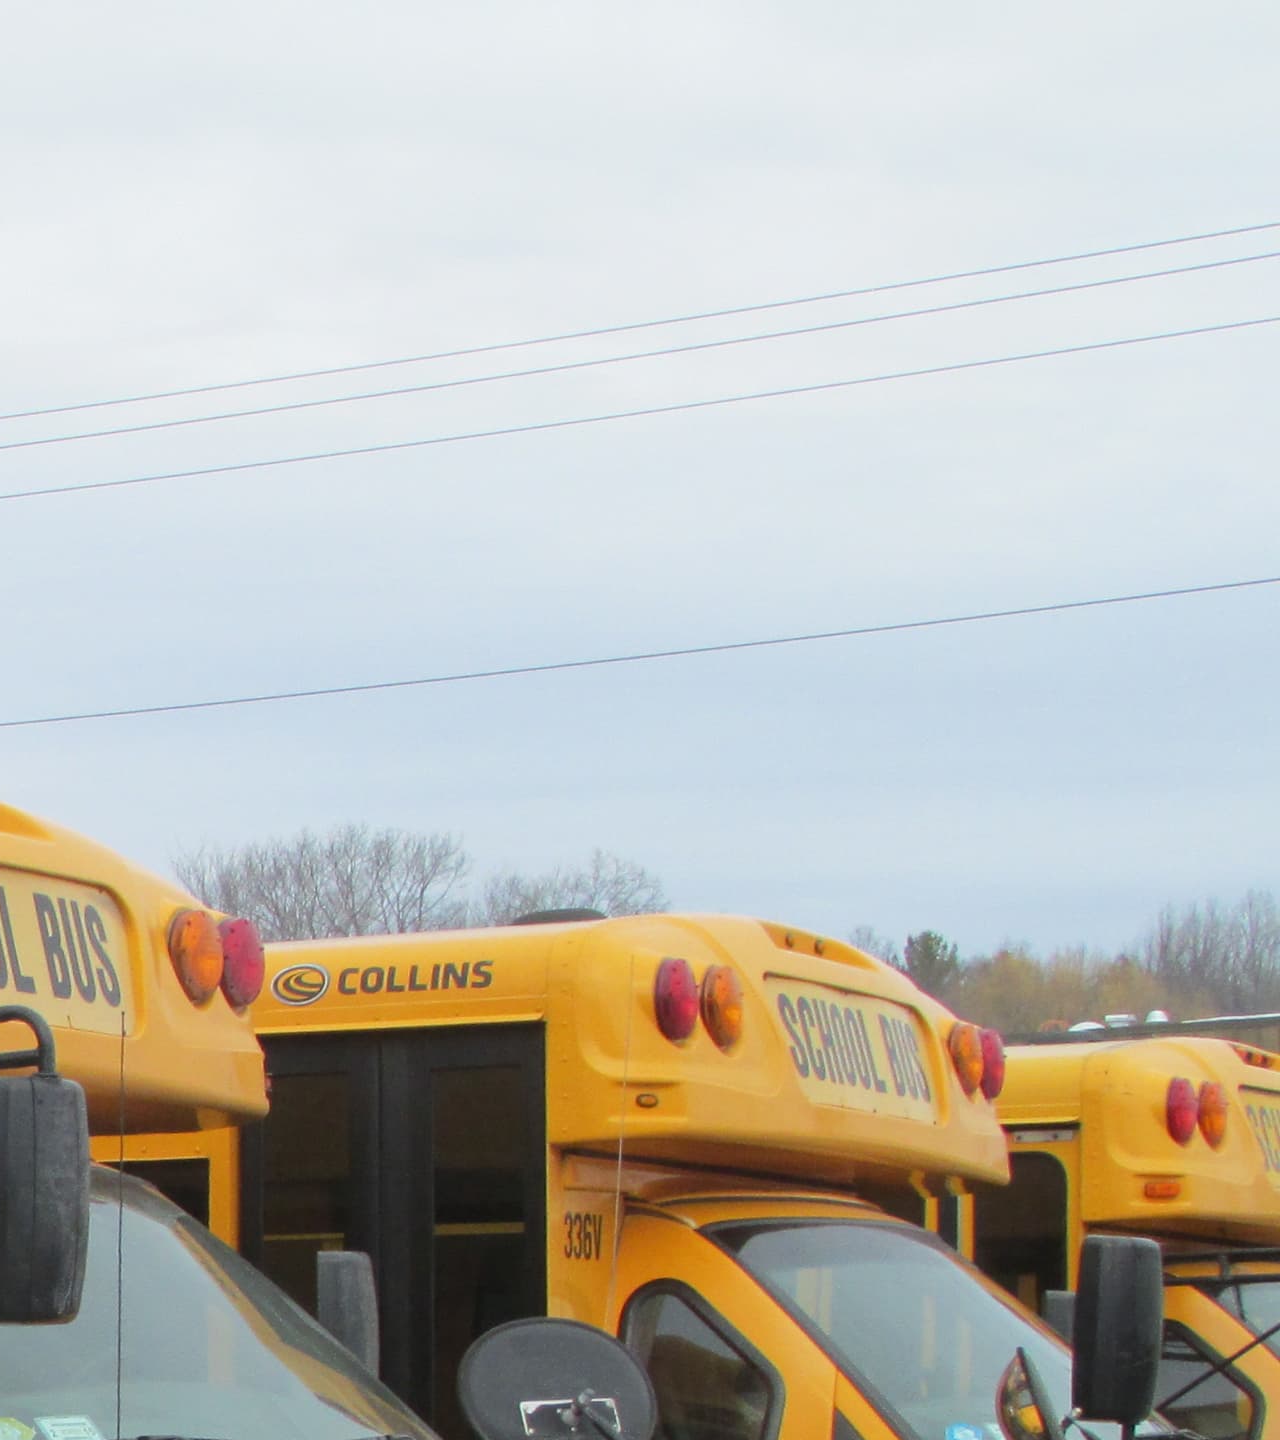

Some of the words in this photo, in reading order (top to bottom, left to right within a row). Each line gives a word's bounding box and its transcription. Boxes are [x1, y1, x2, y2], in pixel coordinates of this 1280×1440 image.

[32, 892, 122, 1007] BUS
[337, 960, 494, 995] COLLINS
[777, 993, 888, 1093] SCHOOL
